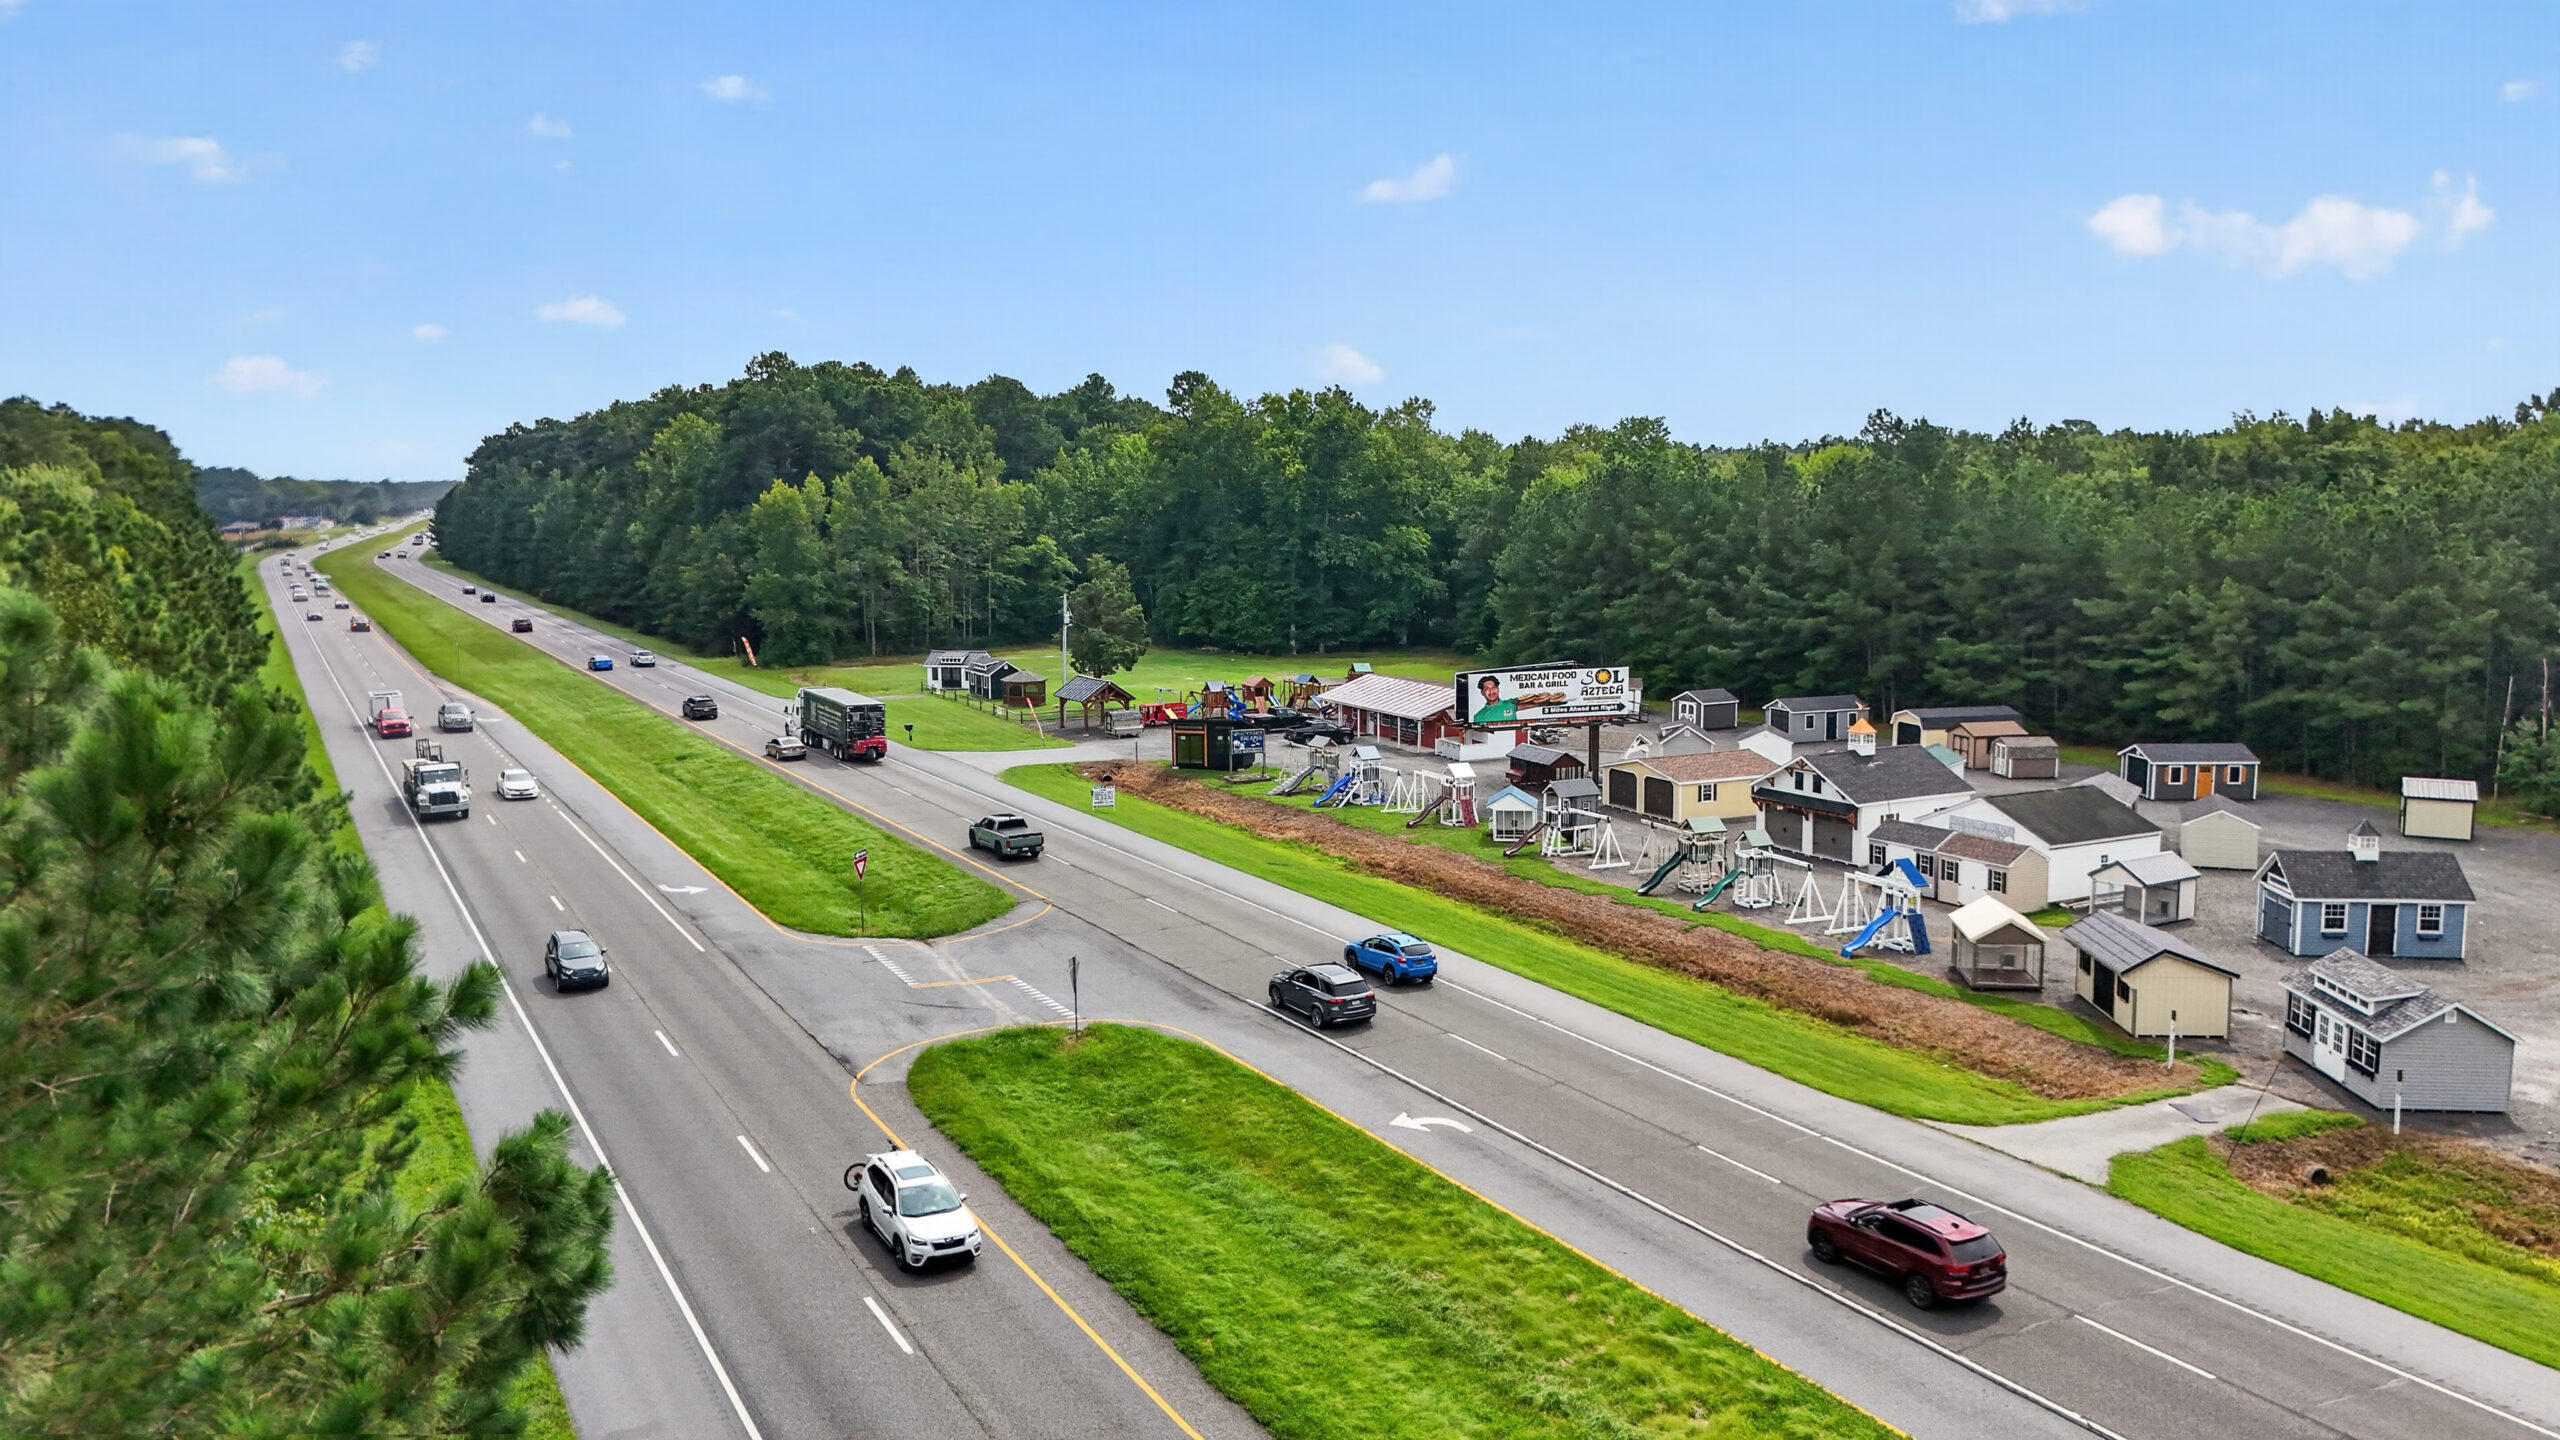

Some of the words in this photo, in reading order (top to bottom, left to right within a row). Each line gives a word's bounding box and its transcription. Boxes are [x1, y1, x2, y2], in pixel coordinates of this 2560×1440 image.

[1510, 673, 1550, 682] MEXICAN
[1552, 671, 1577, 680] FOOD
[1581, 669, 1624, 685] SOL
[1580, 684, 1624, 696] AZTECA
